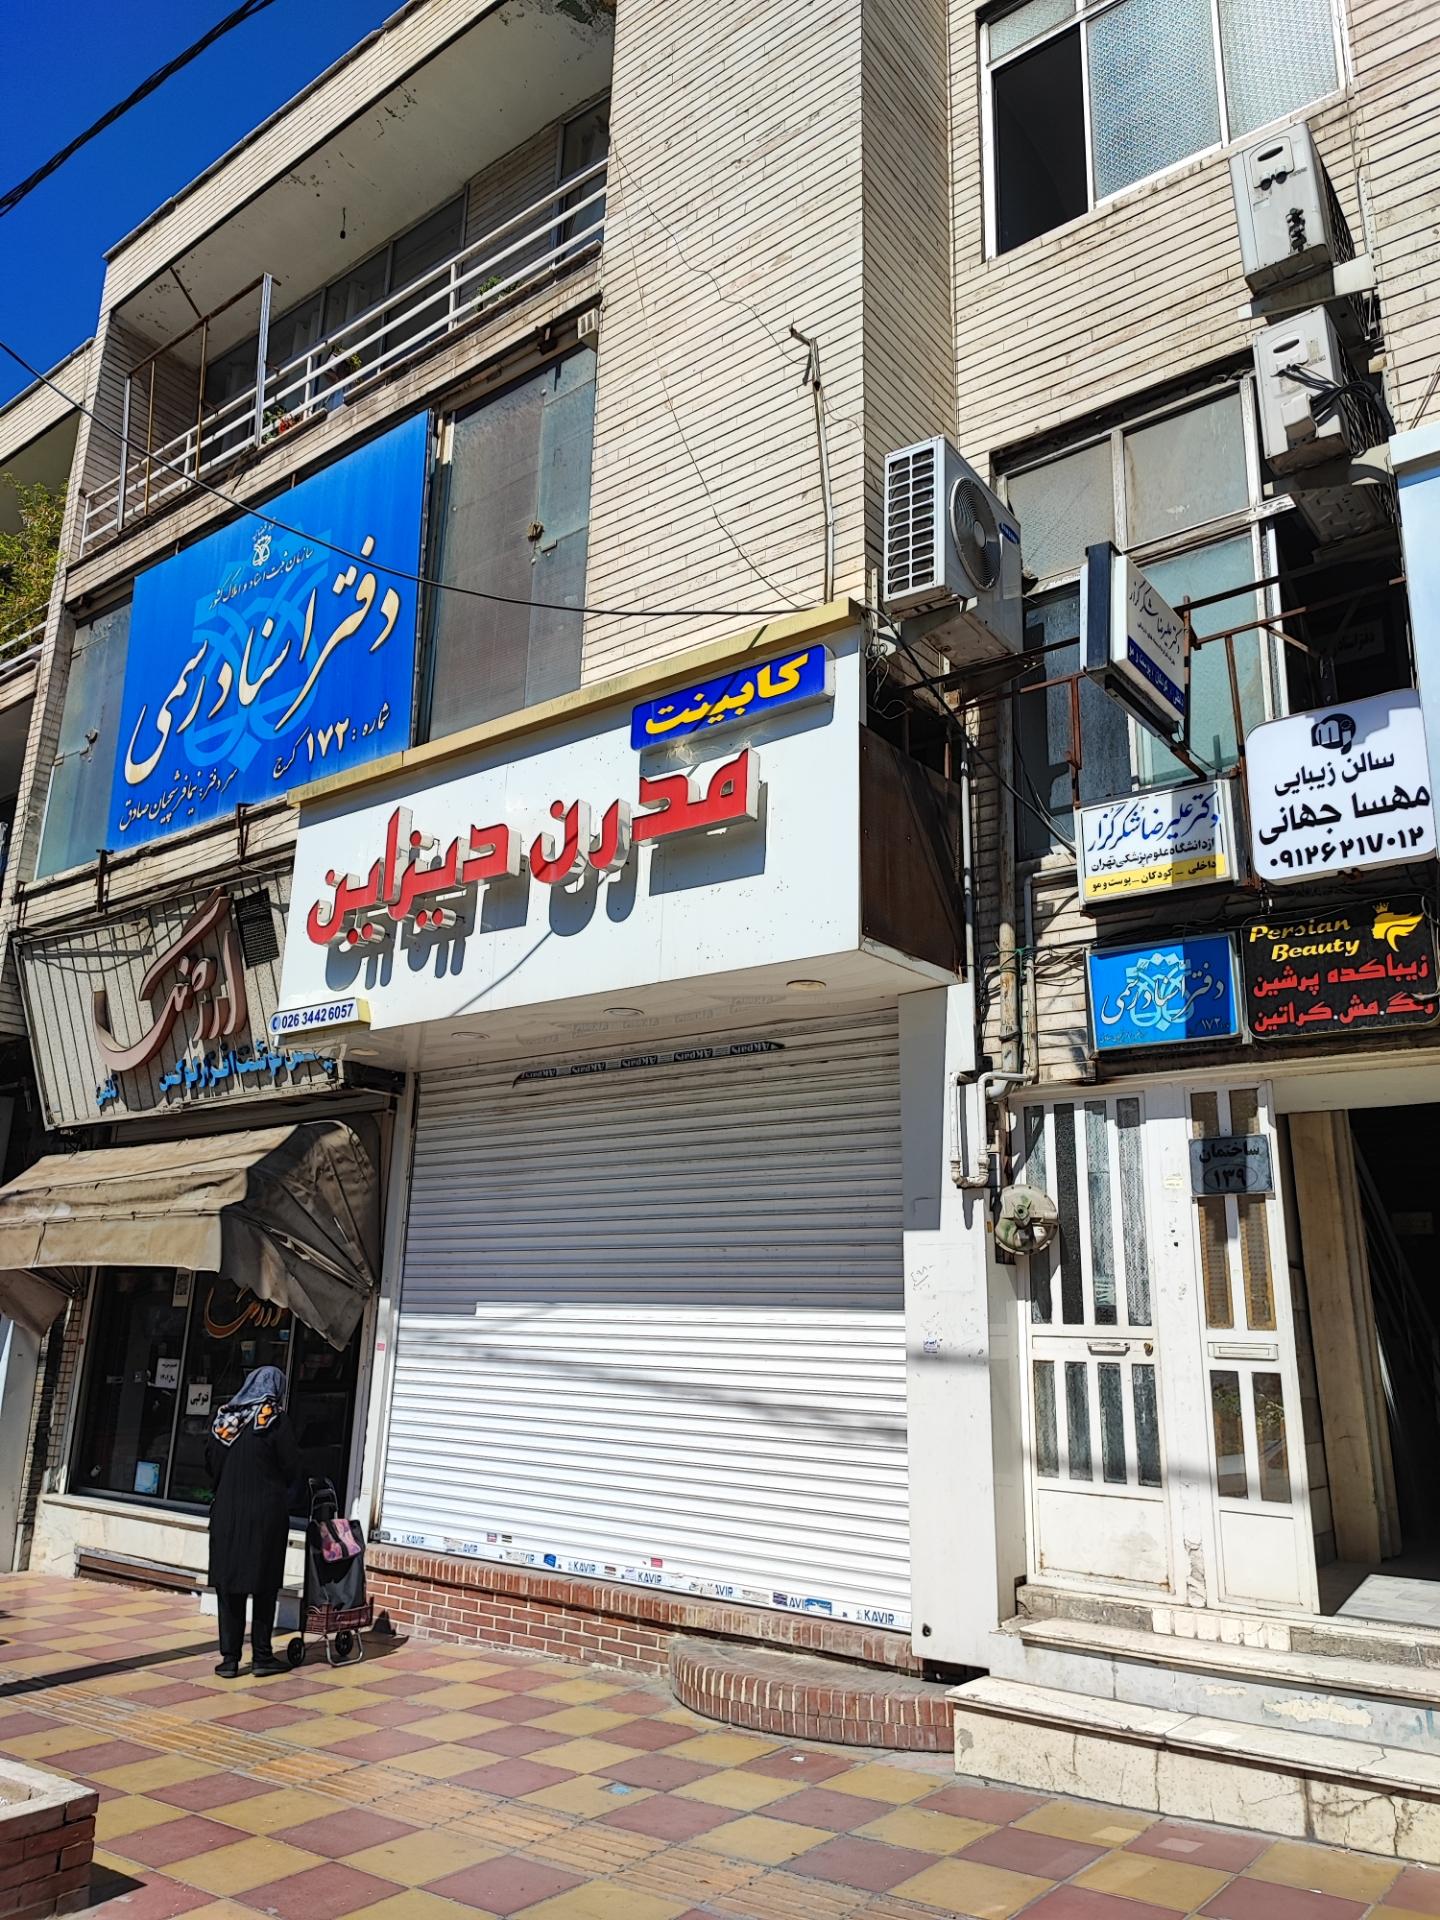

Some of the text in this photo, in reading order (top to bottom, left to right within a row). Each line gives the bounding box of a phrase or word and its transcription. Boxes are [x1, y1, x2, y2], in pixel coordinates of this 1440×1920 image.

[124, 535, 400, 785] دفتر اسناد رسمی
[646, 653, 808, 736] کابینت
[272, 726, 310, 779] کرج
[306, 717, 350, 763] ۱۷۲
[1274, 750, 1395, 796] سالن زیبایی
[118, 799, 151, 832] صادق
[1141, 802, 1193, 841] علیرضا
[1181, 790, 1220, 837] دکتر
[1258, 784, 1431, 845] مهسا جهانی
[307, 748, 757, 946] مدرن دیزاین
[1115, 851, 1147, 868] پزشکی
[1146, 848, 1169, 864] علوم
[1170, 839, 1208, 856] دانشگاه
[1270, 825, 1424, 868] ۰۹۱۲۶۲۱۷۰۱۲
[1091, 855, 1116, 872] تهران
[1141, 867, 1173, 884] کودکان
[1188, 860, 1217, 875] داخلی
[1092, 882, 1102, 893] مو
[1108, 876, 1132, 888] پوست
[1249, 918, 1361, 962] Persian Beauty
[1253, 952, 1429, 998] زیباکده پرشین
[1101, 962, 1225, 1025] دفتر اسناد رسمی
[281, 1015, 299, 1029] 026
[1199, 1140, 1260, 1163] ساختمان
[1213, 1168, 1247, 1188] ۱۳۹
[573, 1560, 596, 1573] KAVIR
[638, 1572, 662, 1584] KAVIR
[863, 1609, 895, 1625] KAVIR
